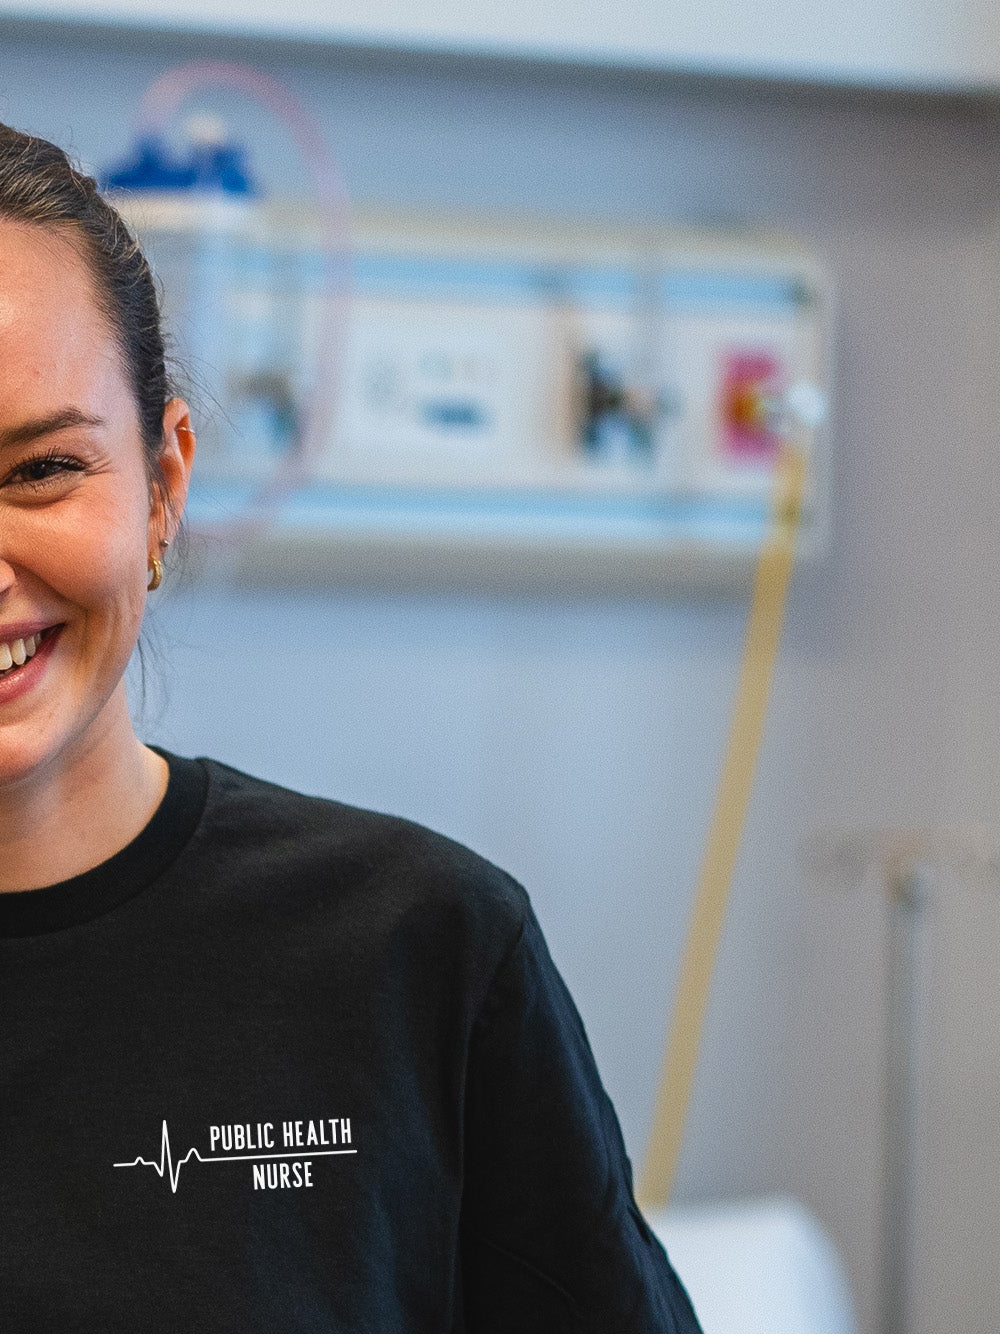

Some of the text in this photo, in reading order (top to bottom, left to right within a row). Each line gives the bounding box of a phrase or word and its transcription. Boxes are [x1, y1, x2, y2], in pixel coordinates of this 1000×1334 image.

[209, 1118, 352, 1152] PUBLIC HEALTH
[252, 1161, 314, 1190] NURSE
